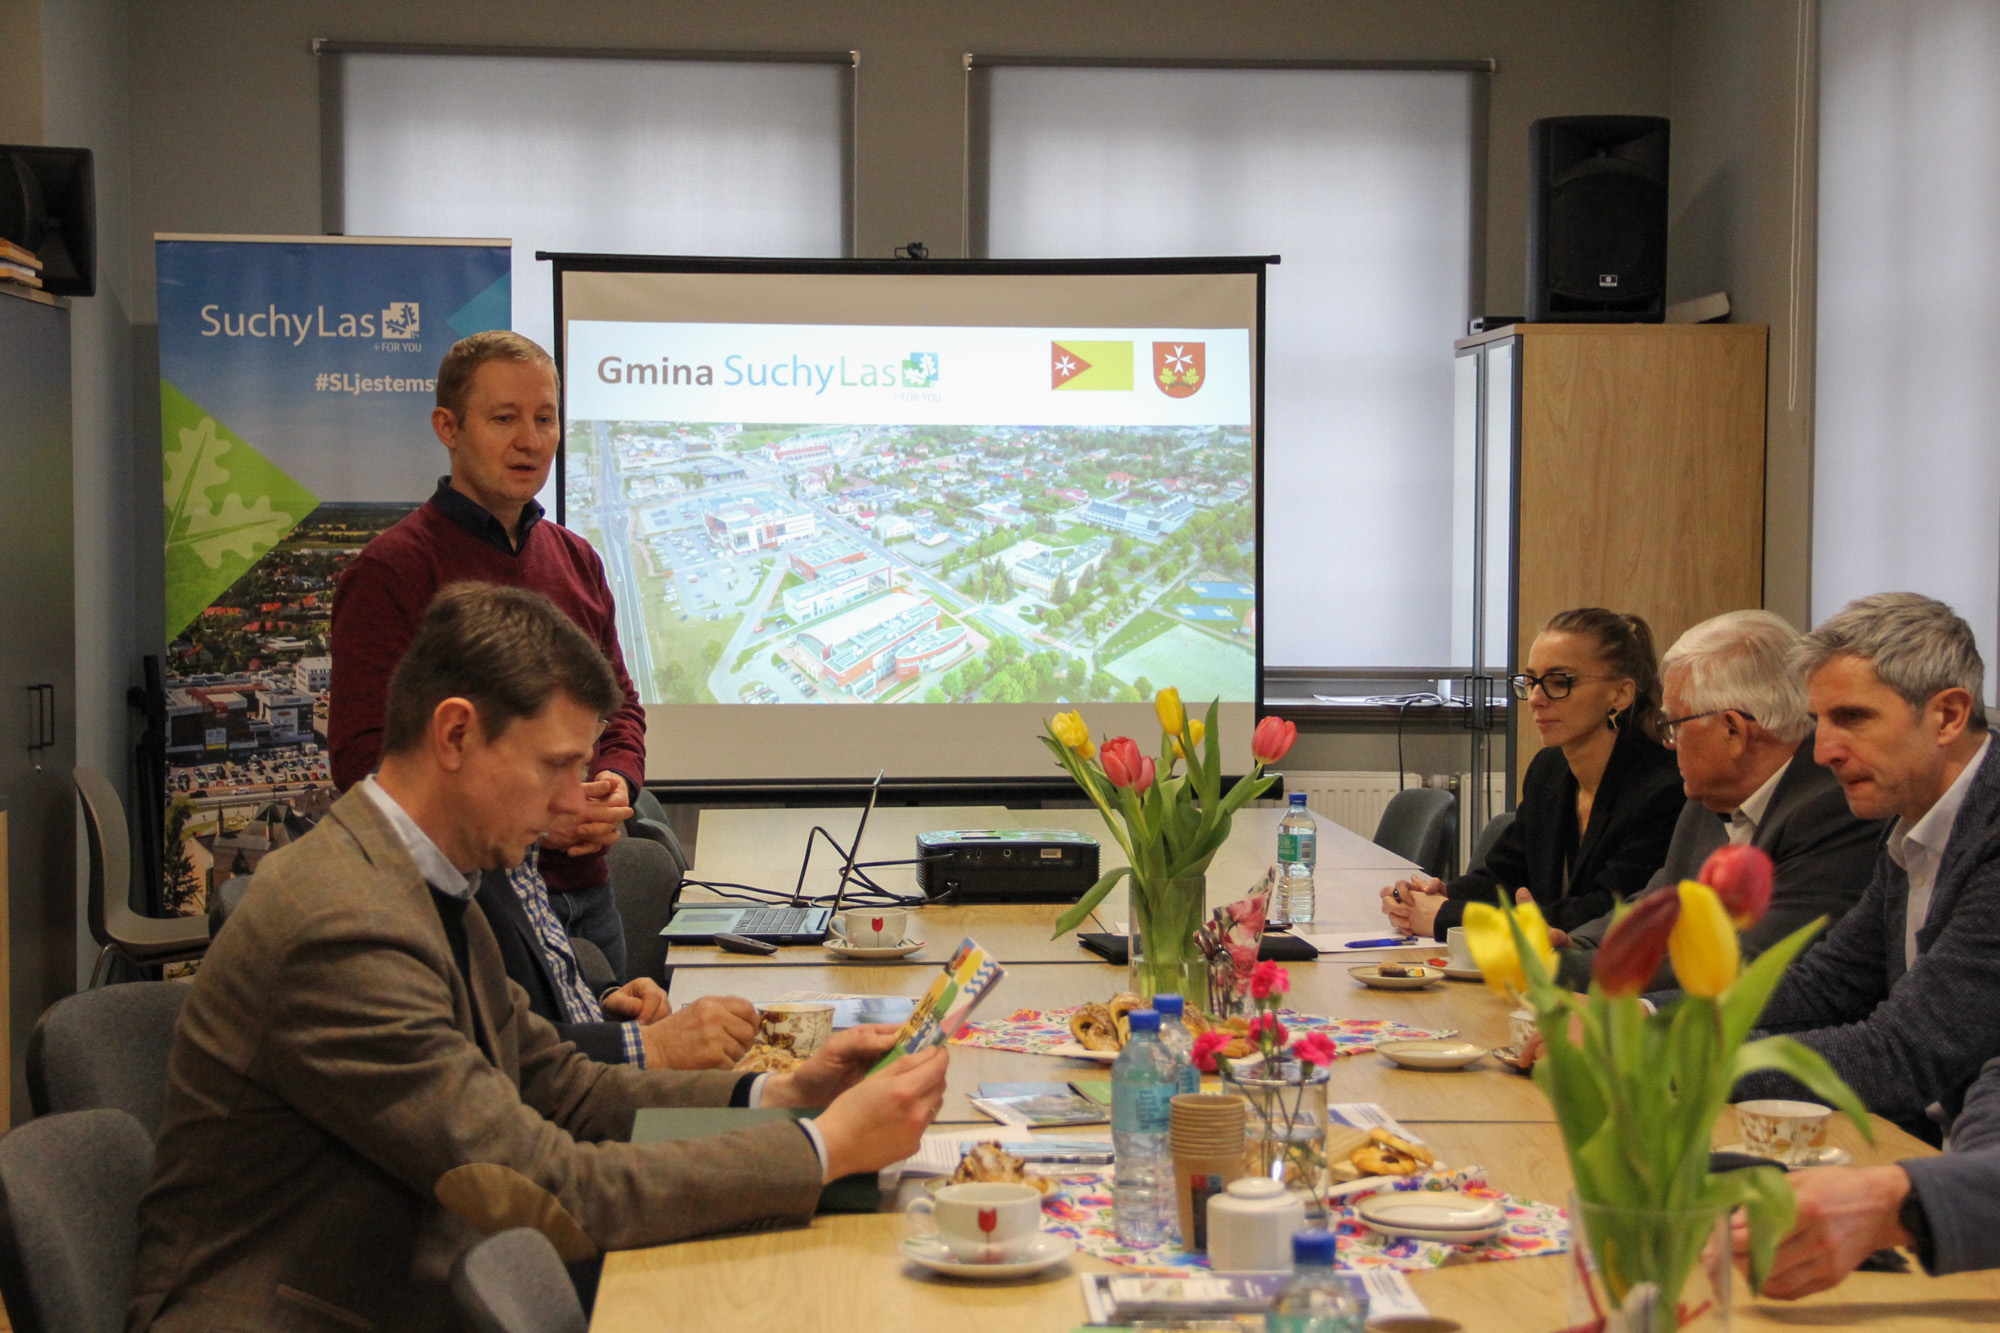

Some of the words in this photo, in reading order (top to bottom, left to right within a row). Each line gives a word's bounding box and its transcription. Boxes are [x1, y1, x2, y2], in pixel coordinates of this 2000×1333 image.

[402, 342, 423, 353] YOU
[597, 356, 714, 386] Gmina
[315, 372, 438, 396] #SLjestems
[921, 392, 942, 402] YOU
